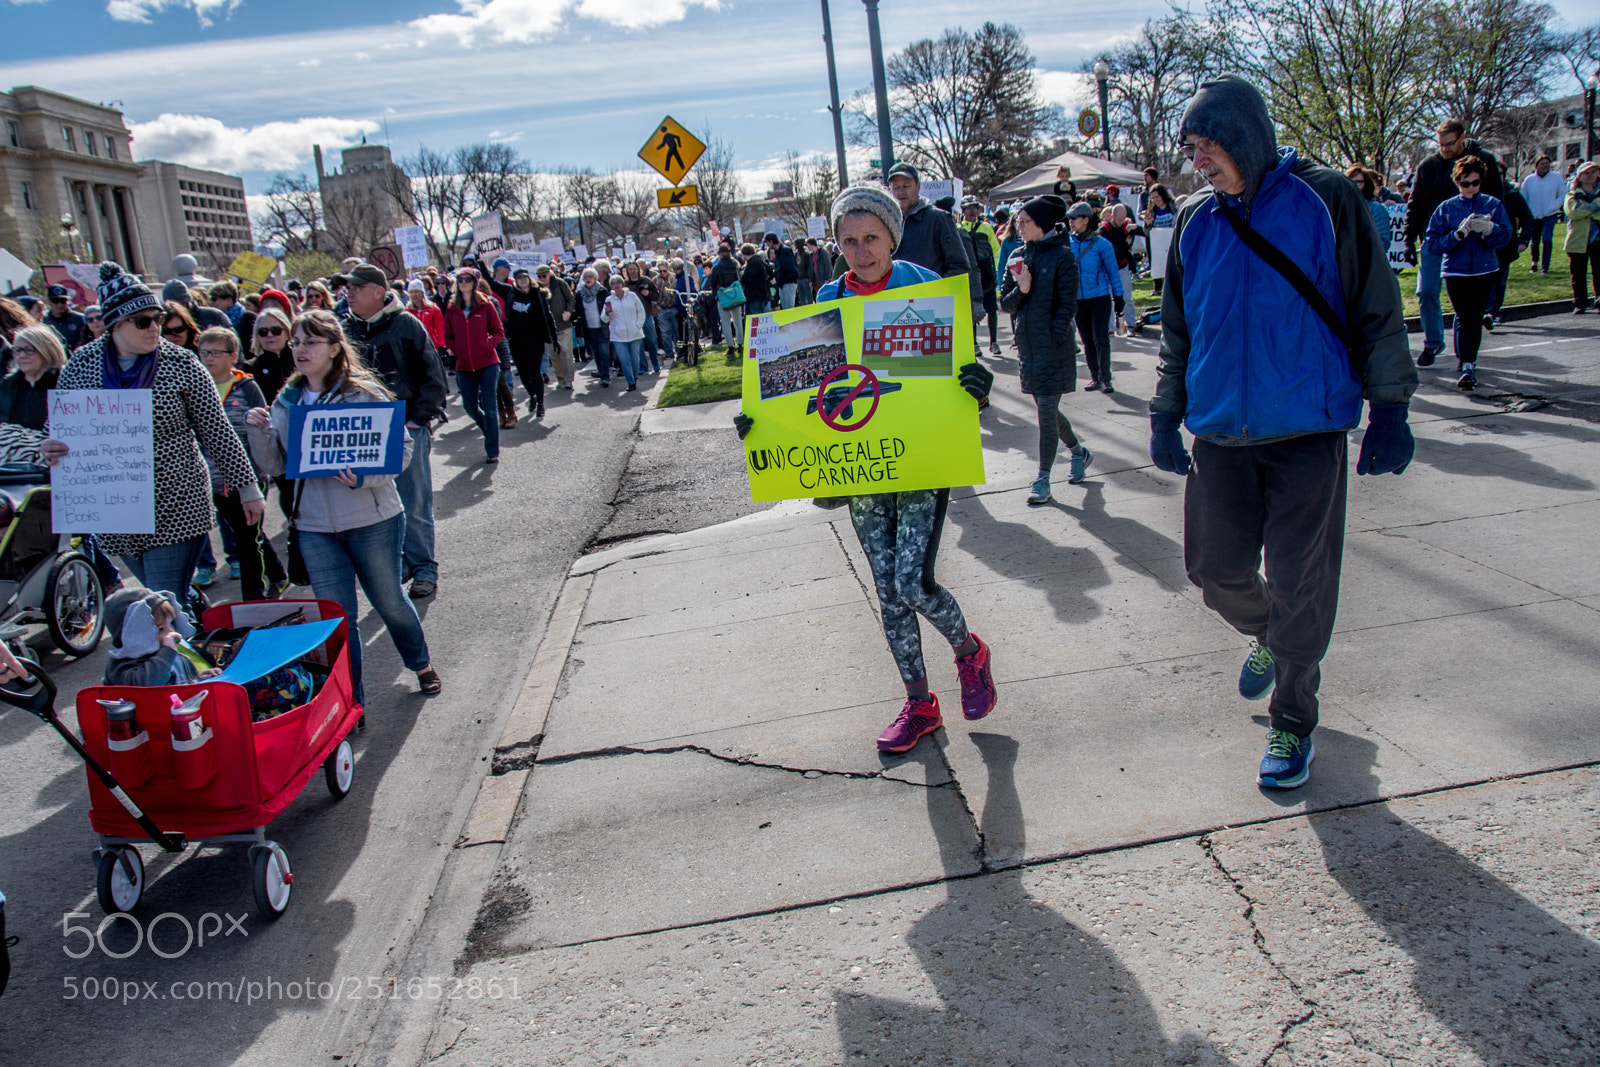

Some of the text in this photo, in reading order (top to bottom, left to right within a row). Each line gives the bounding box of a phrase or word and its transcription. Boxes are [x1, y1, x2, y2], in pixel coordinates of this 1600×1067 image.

[751, 338, 768, 347] FOR
[89, 418, 120, 437] School
[311, 416, 372, 432] MARCH
[311, 432, 381, 448] FOR OUR
[82, 445, 99, 457] and
[309, 449, 357, 465] LIVES
[62, 463, 72, 474] to
[74, 461, 114, 474] Address
[799, 461, 899, 489] CARNAGE
[130, 490, 144, 504] of
